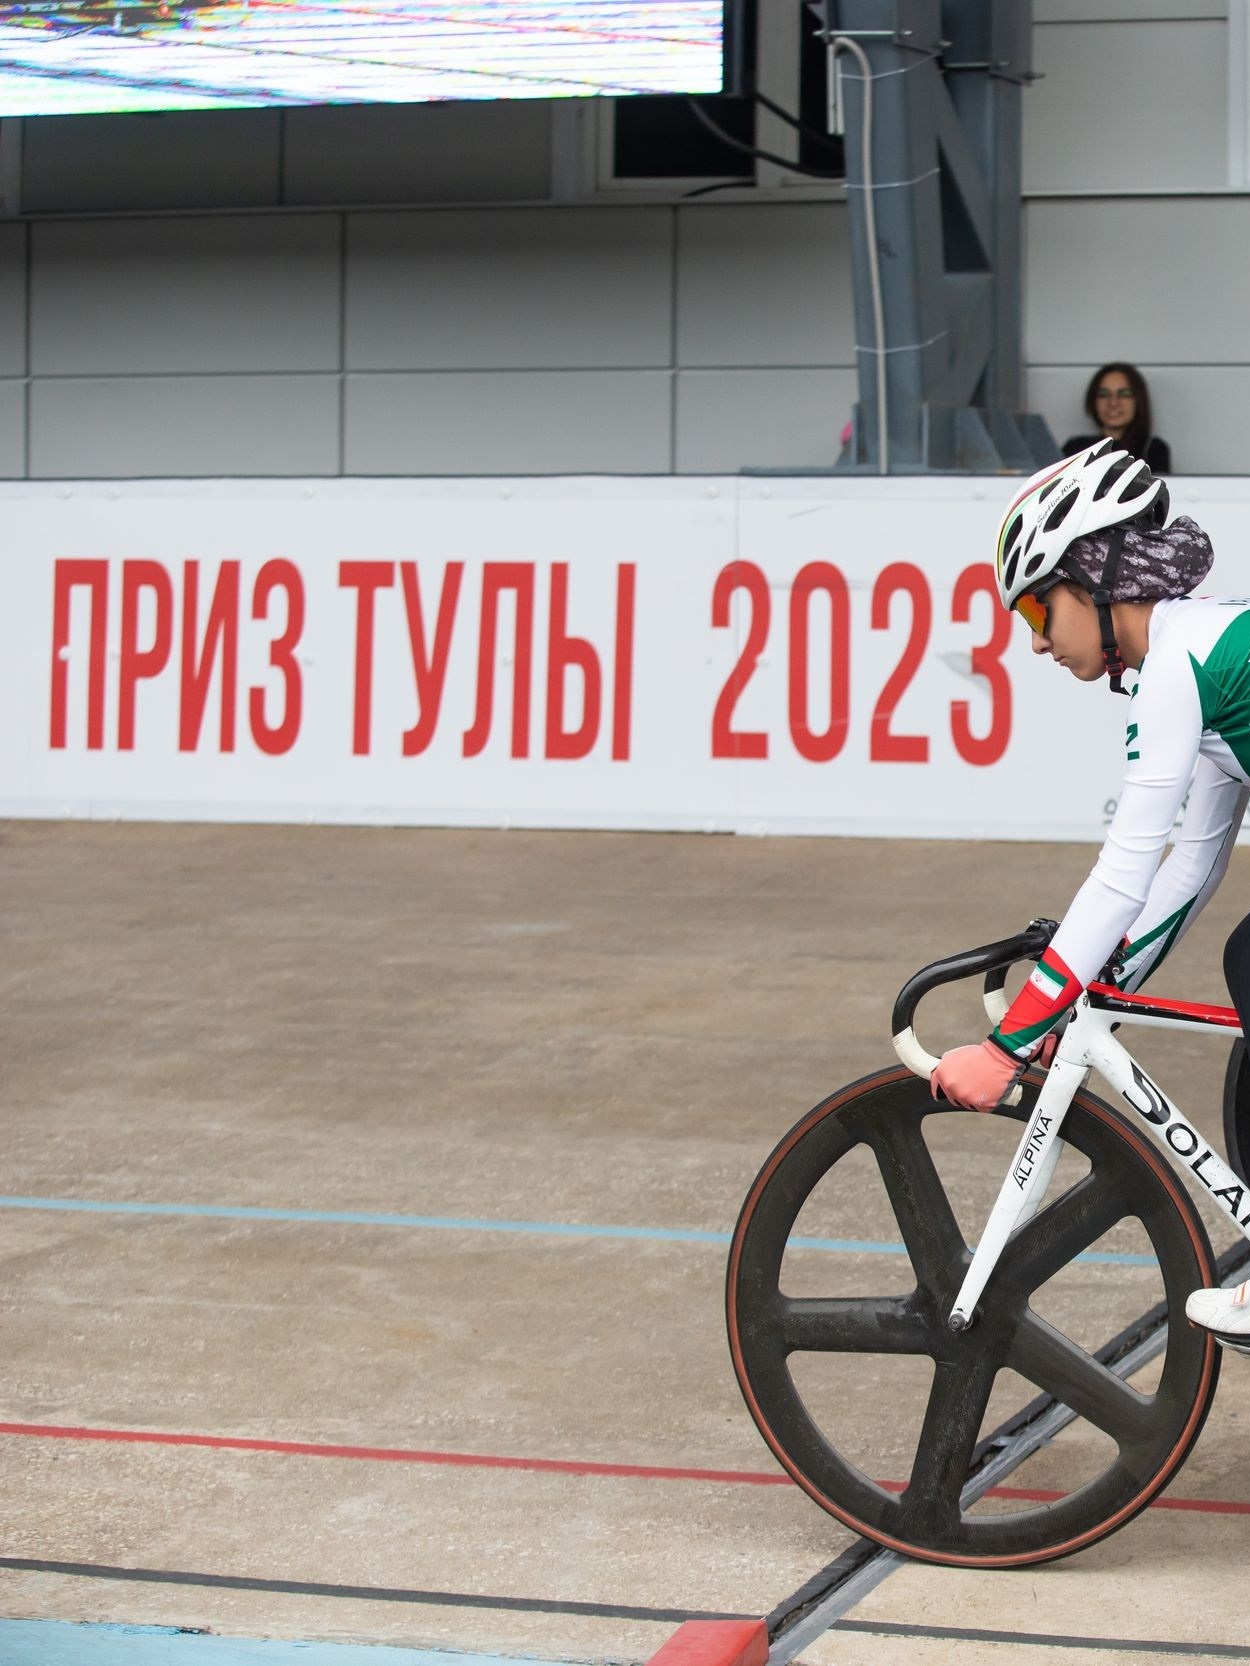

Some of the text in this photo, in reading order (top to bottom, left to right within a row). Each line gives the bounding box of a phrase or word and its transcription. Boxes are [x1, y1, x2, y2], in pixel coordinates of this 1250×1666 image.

[49, 557, 1013, 767] ПРИЗ ТУЛЫ 2023
[1013, 1112, 1053, 1191] ALPINA
